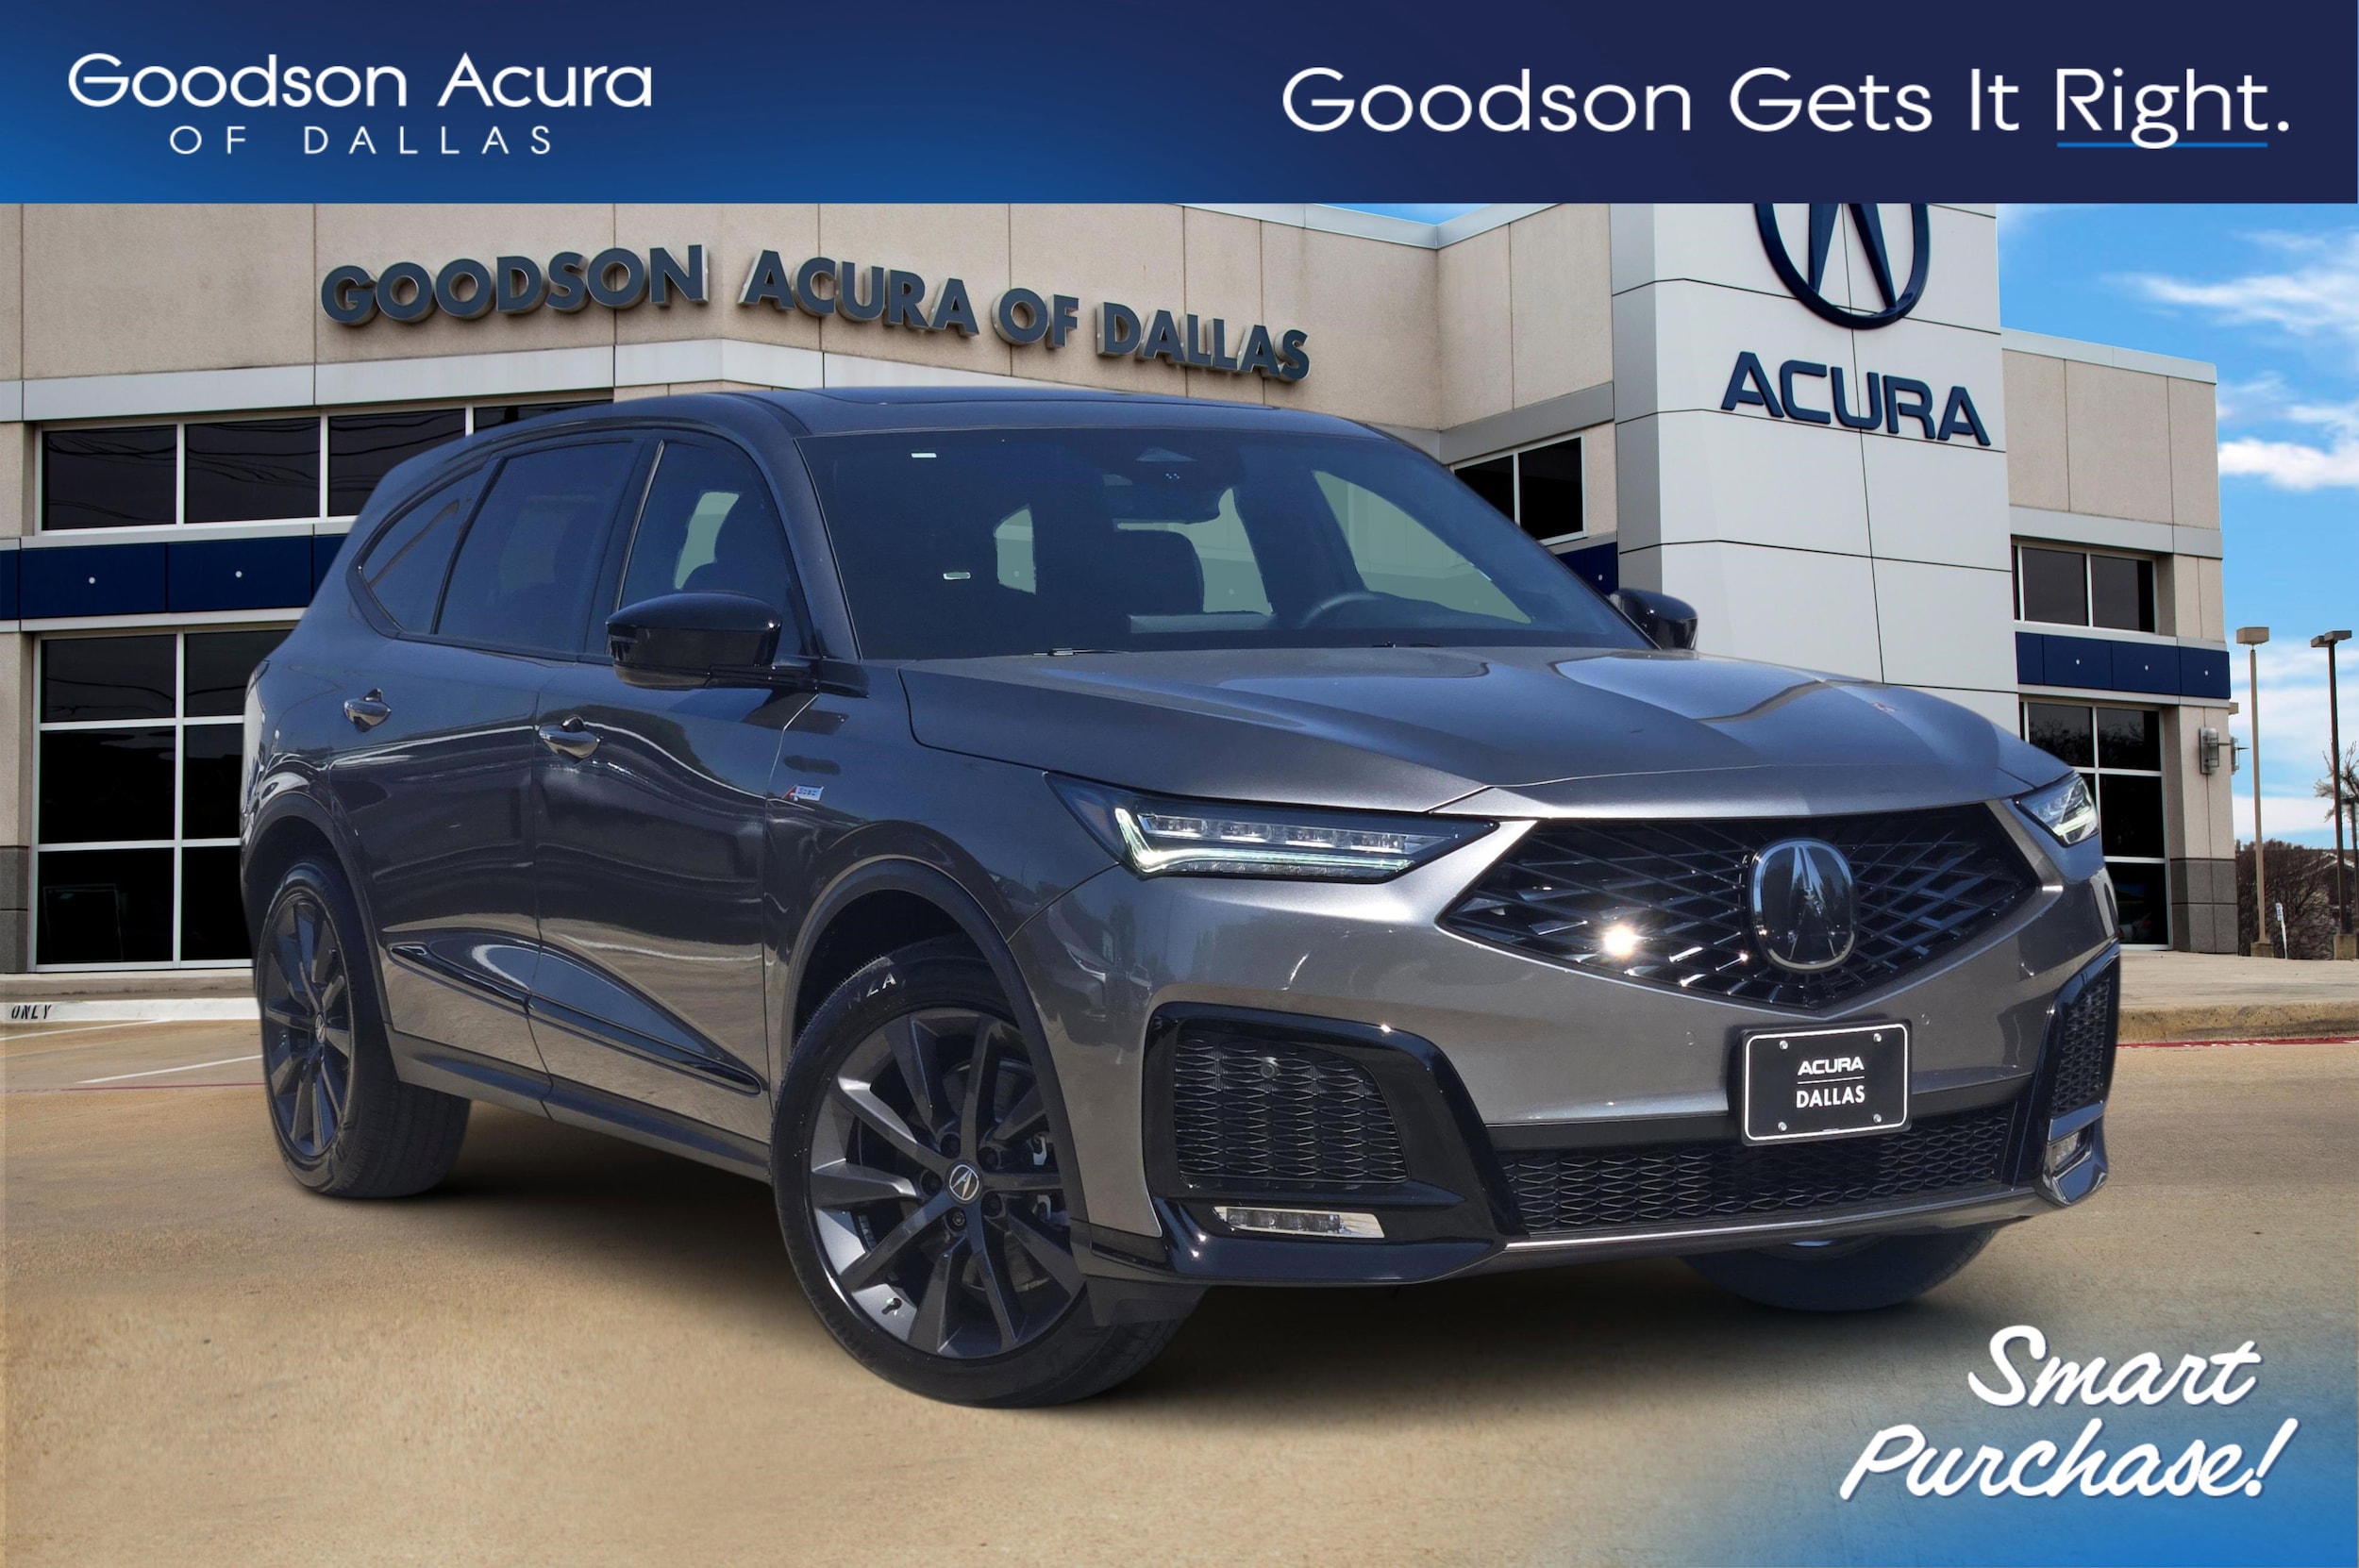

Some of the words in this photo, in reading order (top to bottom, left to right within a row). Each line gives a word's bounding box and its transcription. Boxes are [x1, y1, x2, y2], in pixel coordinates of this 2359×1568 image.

[321, 244, 710, 327] GOODSON
[738, 249, 979, 337] ACURA
[992, 287, 1079, 349] OF
[1096, 300, 1310, 383] DALLAS
[1720, 350, 1991, 446] ACURA
[11, 1004, 52, 1020] ONLY
[1797, 1056, 1865, 1076] ACURA
[1796, 1085, 1865, 1109] DALLAS
